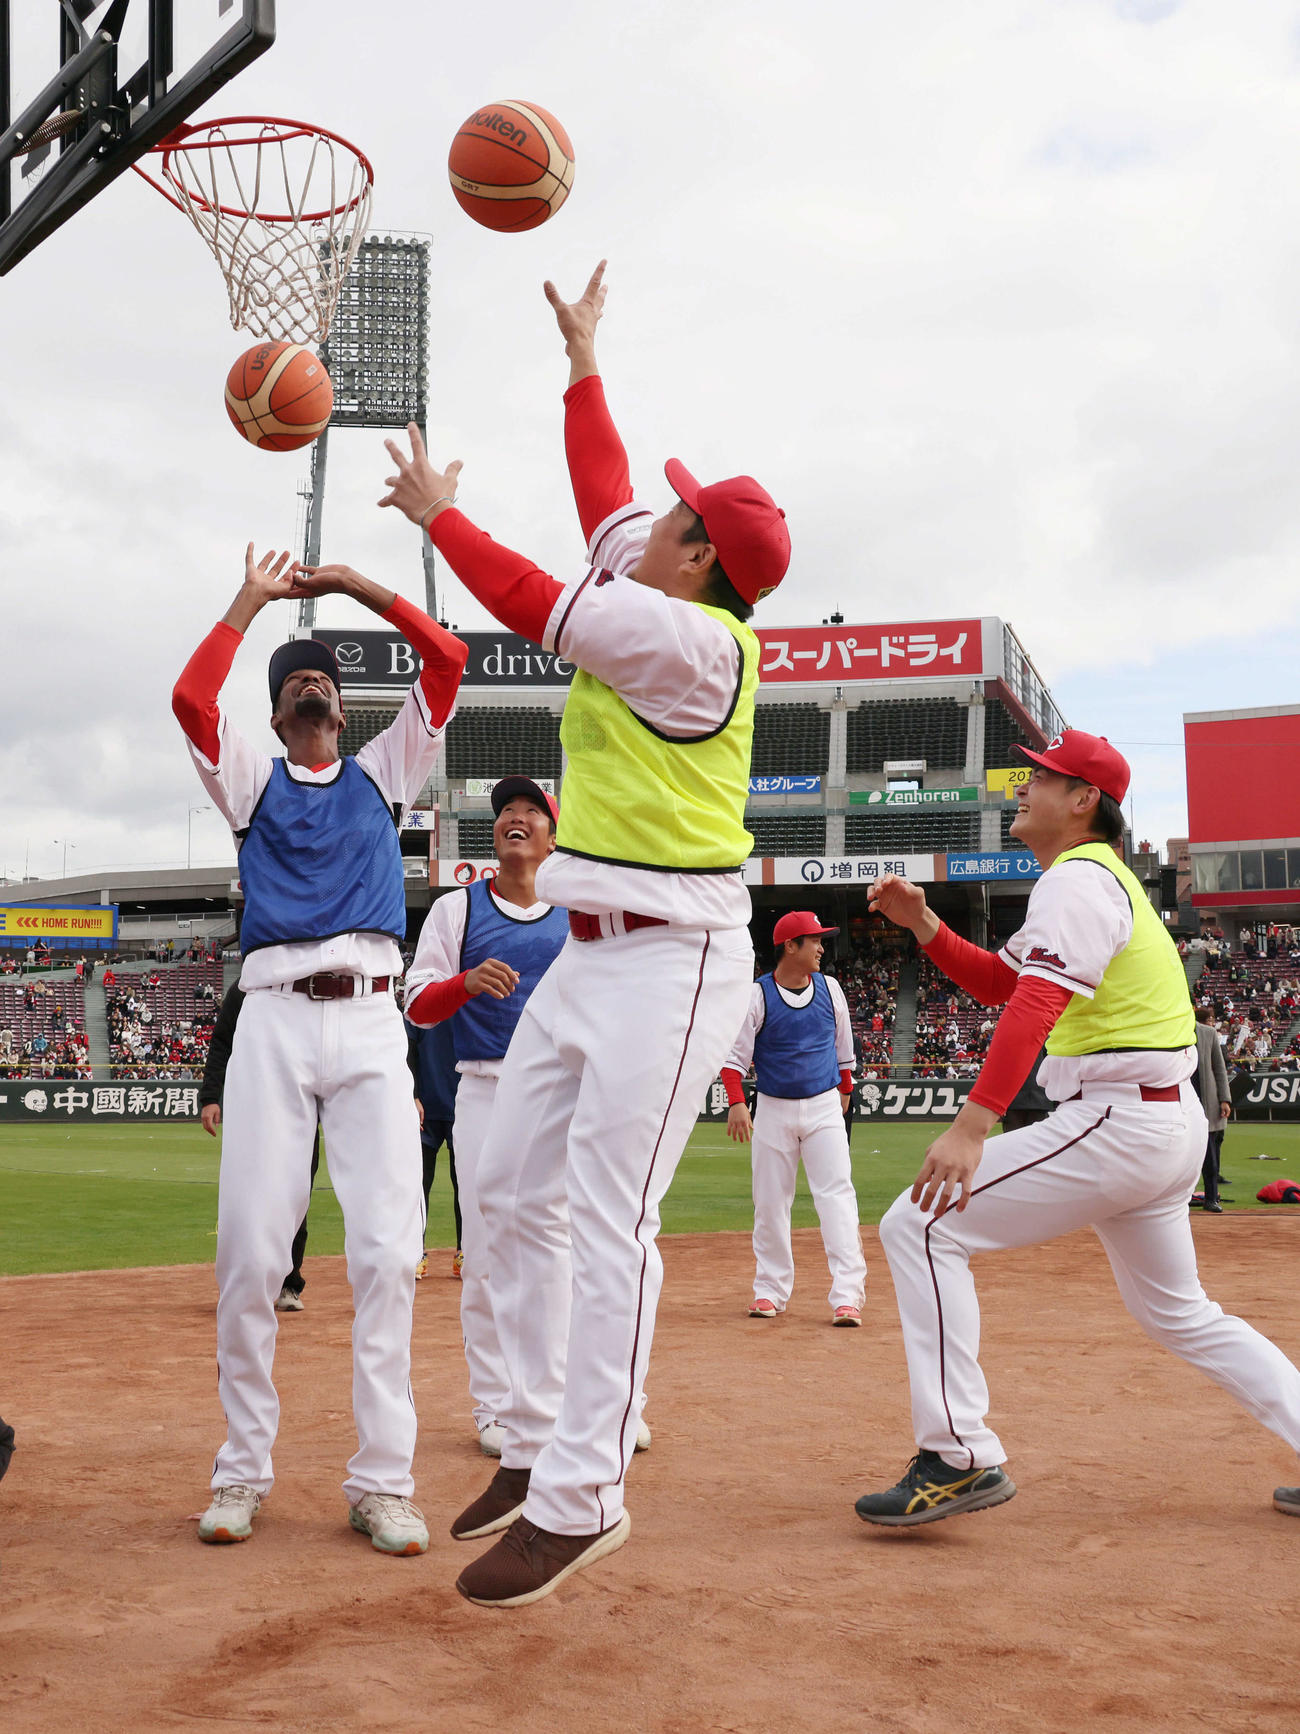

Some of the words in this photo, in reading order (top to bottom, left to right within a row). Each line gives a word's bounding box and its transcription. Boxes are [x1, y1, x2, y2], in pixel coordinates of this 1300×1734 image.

[763, 632, 968, 672] スーパードライ
[885, 789, 960, 804] Zenhoren
[950, 859, 1011, 875] 広島銀行
[42, 917, 68, 929] HOME
[71, 918, 102, 929] RUN!!!!
[53, 1086, 200, 1116] 中國新聞
